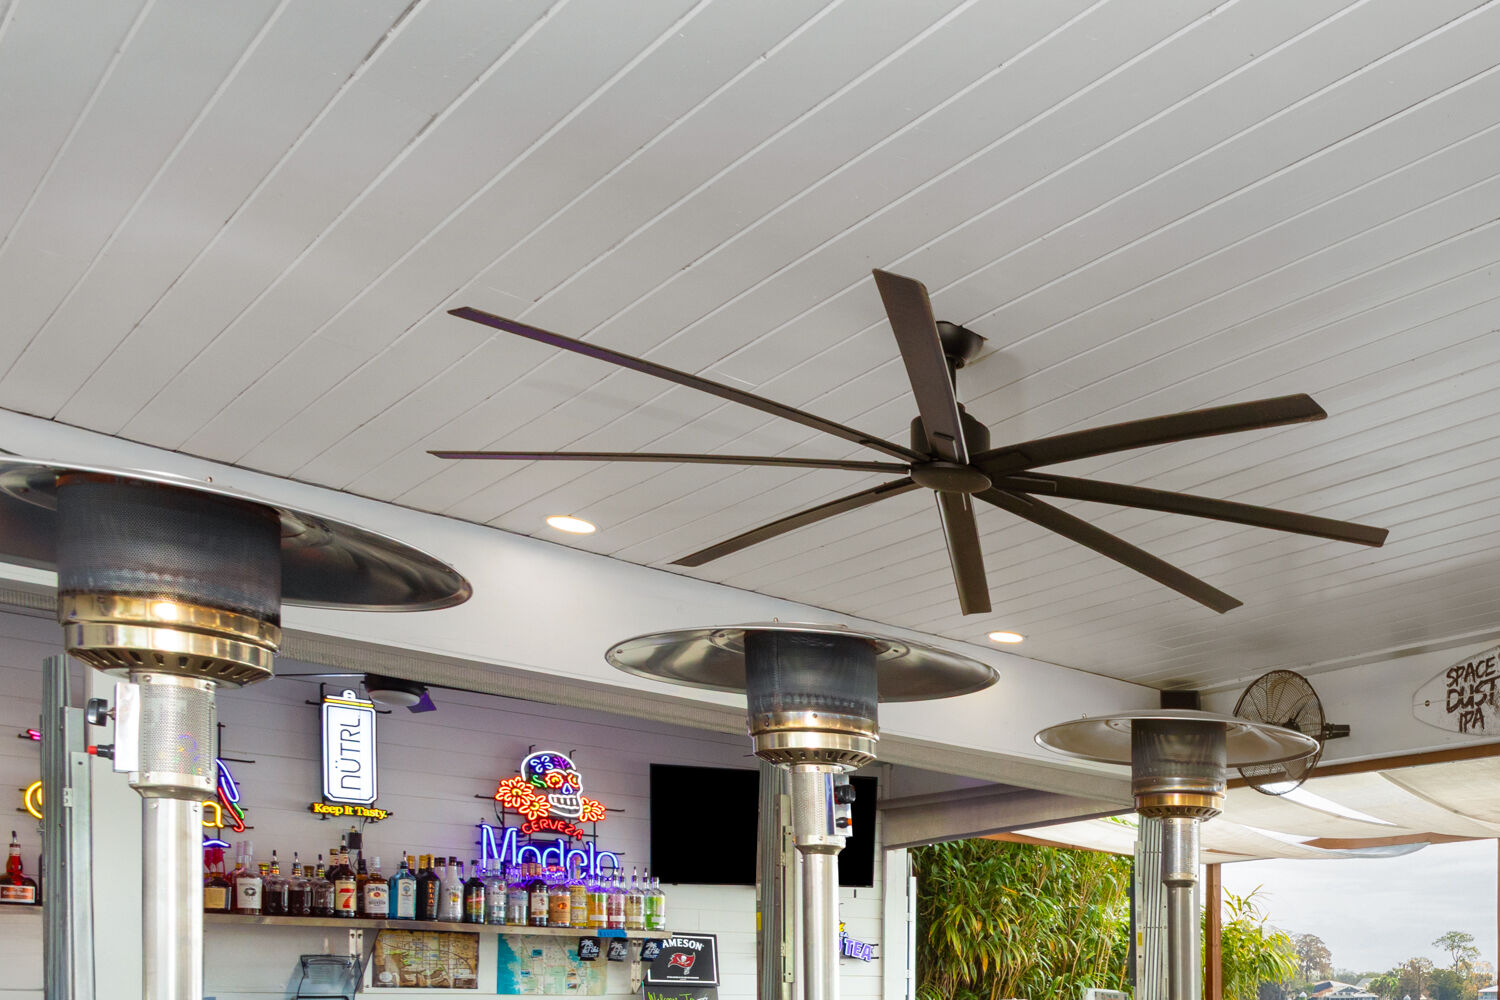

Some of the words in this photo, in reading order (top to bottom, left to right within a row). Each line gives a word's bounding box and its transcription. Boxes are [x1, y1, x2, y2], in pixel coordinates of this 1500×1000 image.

[1446, 656, 1496, 688] SPACE
[1446, 675, 1500, 713] DUST
[1458, 706, 1485, 733] IPA
[313, 803, 343, 815] Keep
[344, 805, 354, 815] It
[355, 806, 388, 819] Tasty.
[521, 818, 584, 840] CERVEZA
[481, 824, 619, 878] Modelo
[339, 888, 355, 909] 7
[662, 939, 702, 951] AMESON
[845, 939, 872, 961] TEA
